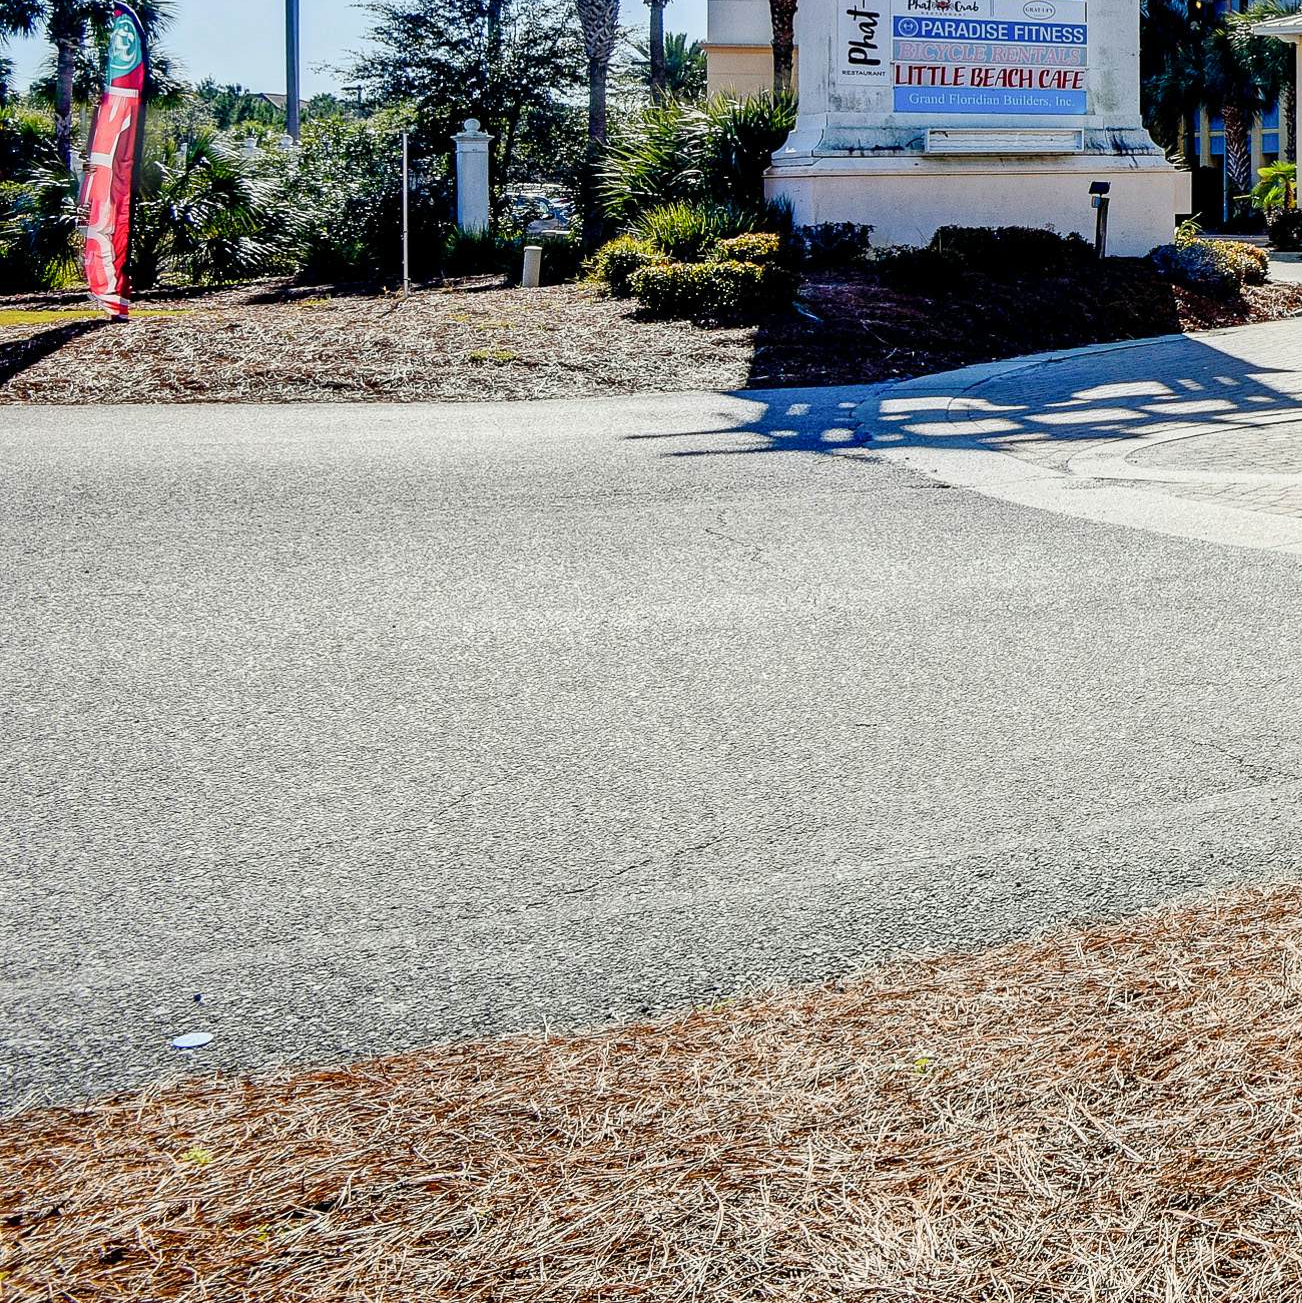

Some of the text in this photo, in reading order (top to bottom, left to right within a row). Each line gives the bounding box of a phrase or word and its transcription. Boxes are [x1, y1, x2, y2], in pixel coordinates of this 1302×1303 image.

[954, 2, 980, 12] Crab
[846, 5, 881, 66] Phat
[921, 20, 1084, 43] PARADISE FITNESS
[898, 41, 1081, 65] BICYCLE RENTALS
[895, 65, 1085, 90] LITTLE BEACH CAFE
[908, 93, 1076, 108] Grand Floridian Builders, Inc.
